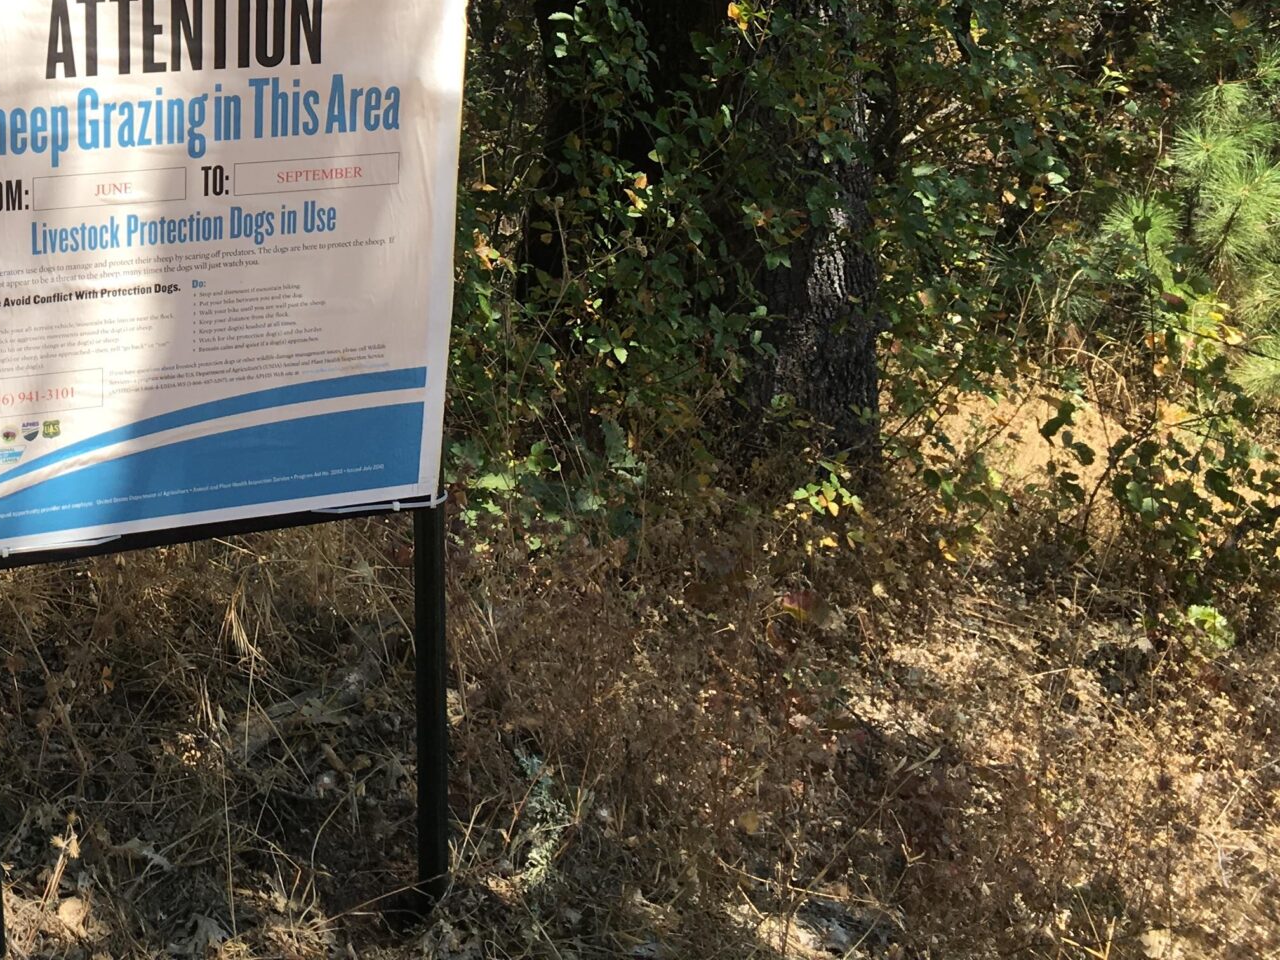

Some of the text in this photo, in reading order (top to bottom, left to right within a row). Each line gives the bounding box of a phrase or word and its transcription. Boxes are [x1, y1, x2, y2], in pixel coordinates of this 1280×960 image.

[77, 87, 208, 159] Grazing
[214, 84, 241, 141] in
[249, 76, 320, 139] This
[326, 73, 401, 135] Area
[94, 182, 133, 197] JUNE
[201, 165, 229, 197] TO:
[276, 165, 363, 185] SEPTEMBER
[31, 201, 337, 256] Livestock Protection Dogs in Use
[39, 265, 55, 275] dogs
[65, 263, 92, 271] manage
[94, 259, 107, 267] and
[109, 258, 133, 269] protect
[135, 255, 151, 264] their
[153, 254, 174, 264] sheep
[175, 253, 183, 263] by
[185, 251, 209, 261] scaring
[211, 249, 221, 258] off
[222, 248, 256, 260] predators.
[258, 246, 271, 254] The
[273, 245, 288, 255] dogs
[327, 240, 351, 251] protect
[365, 237, 385, 247] sheep.
[6, 279, 29, 289] appear
[100, 270, 121, 280] sheep,
[123, 270, 142, 278] many
[164, 265, 175, 273] the
[177, 264, 193, 274] dogs
[194, 261, 207, 270] will
[208, 261, 221, 271] just
[223, 258, 244, 267] watch
[245, 259, 259, 268] you.
[192, 280, 206, 288] Do:
[3, 296, 31, 307] Avoid
[33, 293, 72, 305] Conflict
[75, 289, 98, 300] With
[101, 286, 152, 298] Protection
[154, 283, 181, 294] Dogs.
[18, 387, 74, 403] 941-3101
